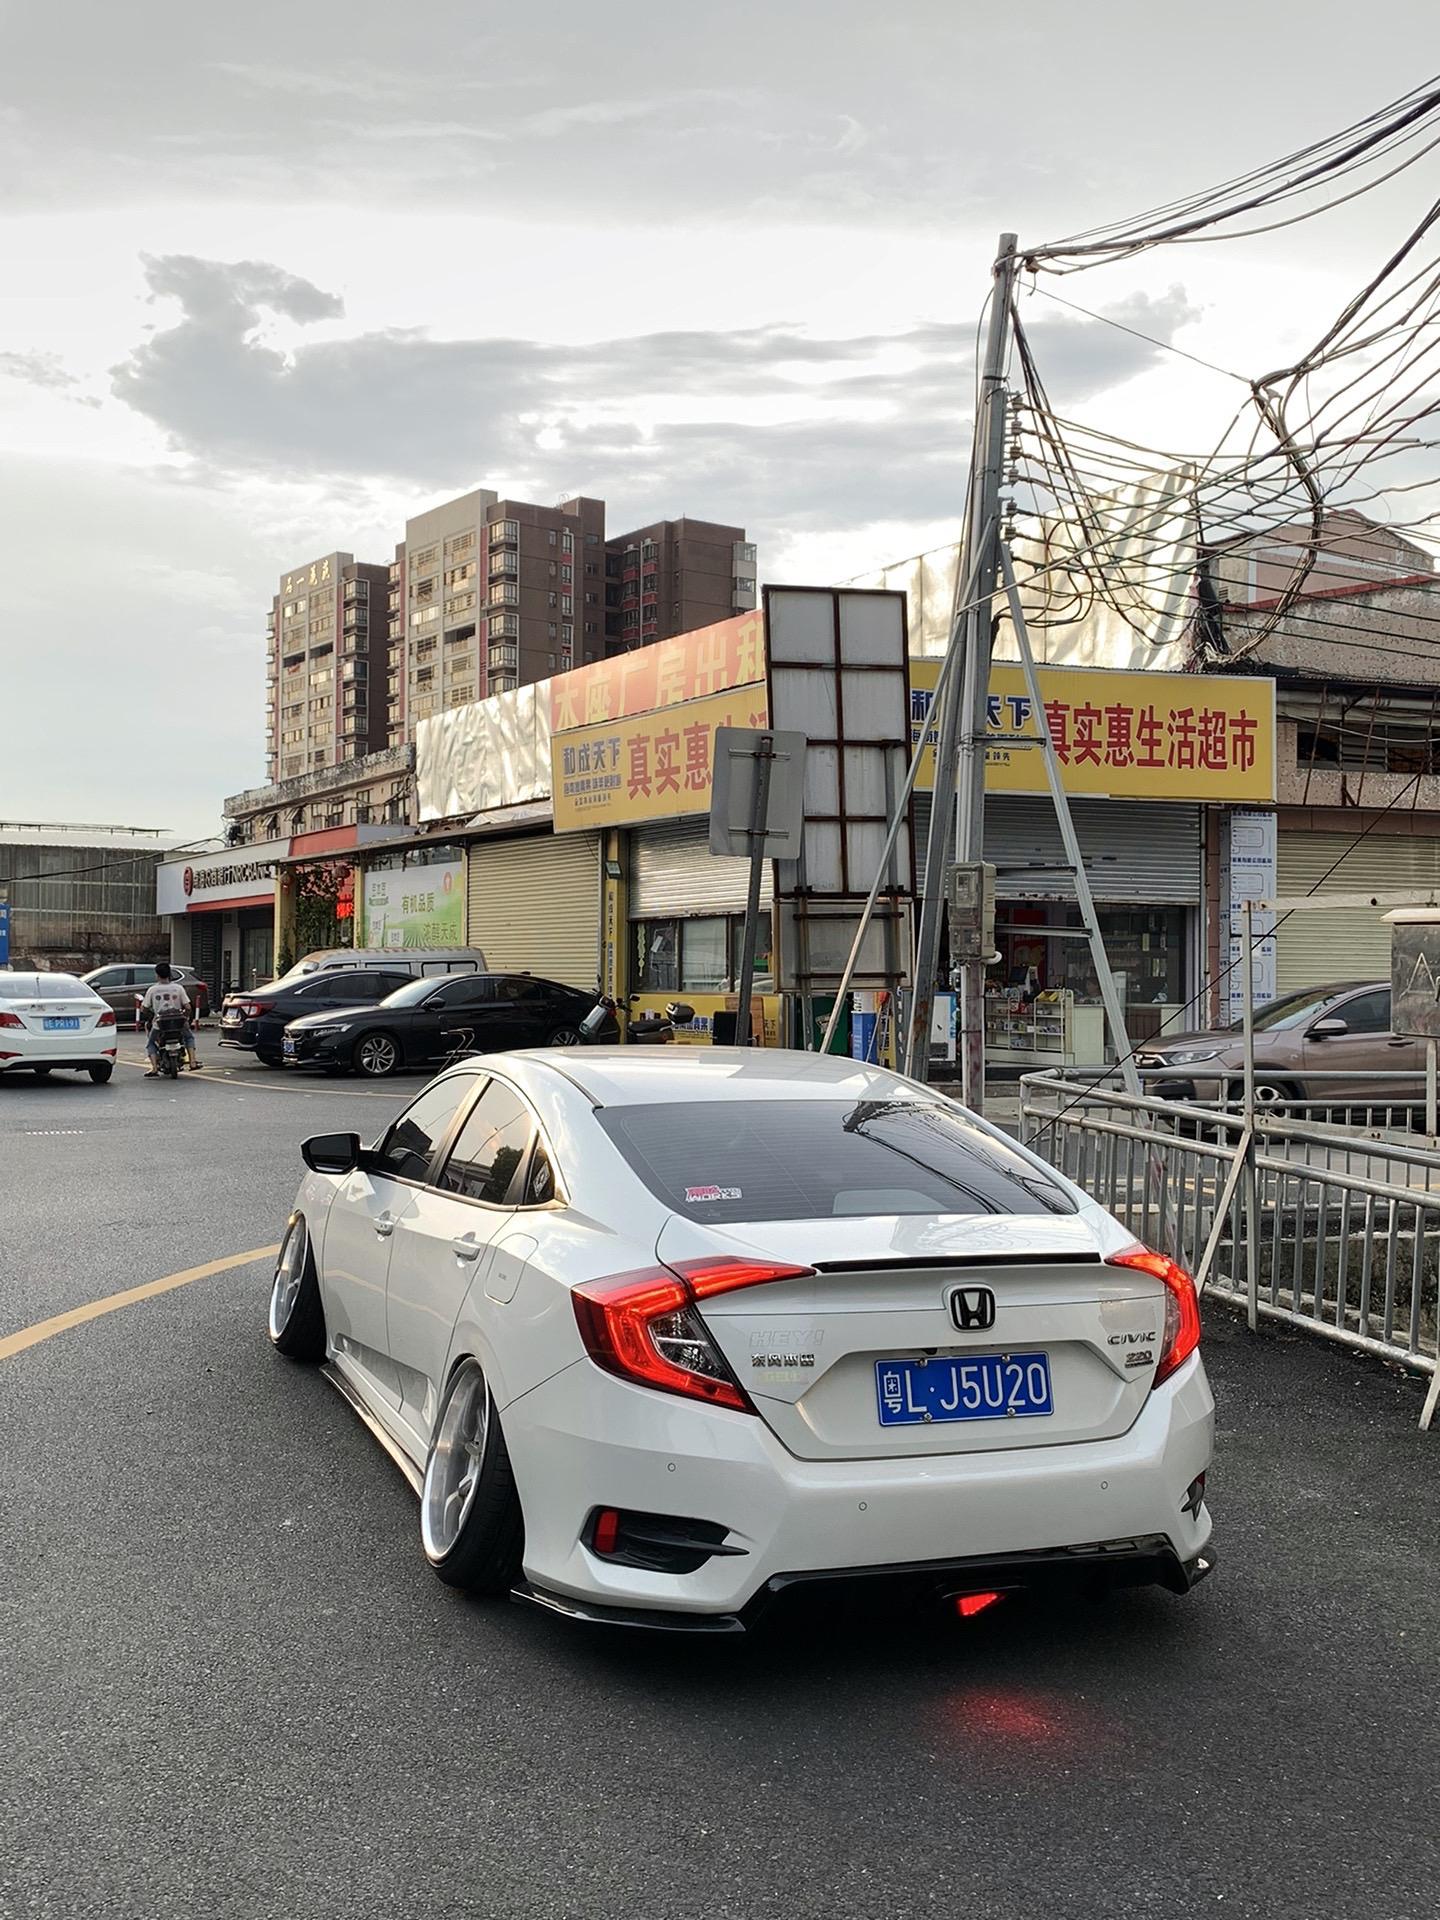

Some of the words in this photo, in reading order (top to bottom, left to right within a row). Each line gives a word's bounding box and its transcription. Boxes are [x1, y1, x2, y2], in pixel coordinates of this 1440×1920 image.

[1044, 699, 1258, 772] 真实惠生活超市
[563, 736, 622, 777] 和成天下
[401, 891, 435, 914] 有机品质
[1107, 1331, 1156, 1346] CIVIC
[751, 1352, 815, 1368] 东风本田
[1126, 1350, 1153, 1362] 220
